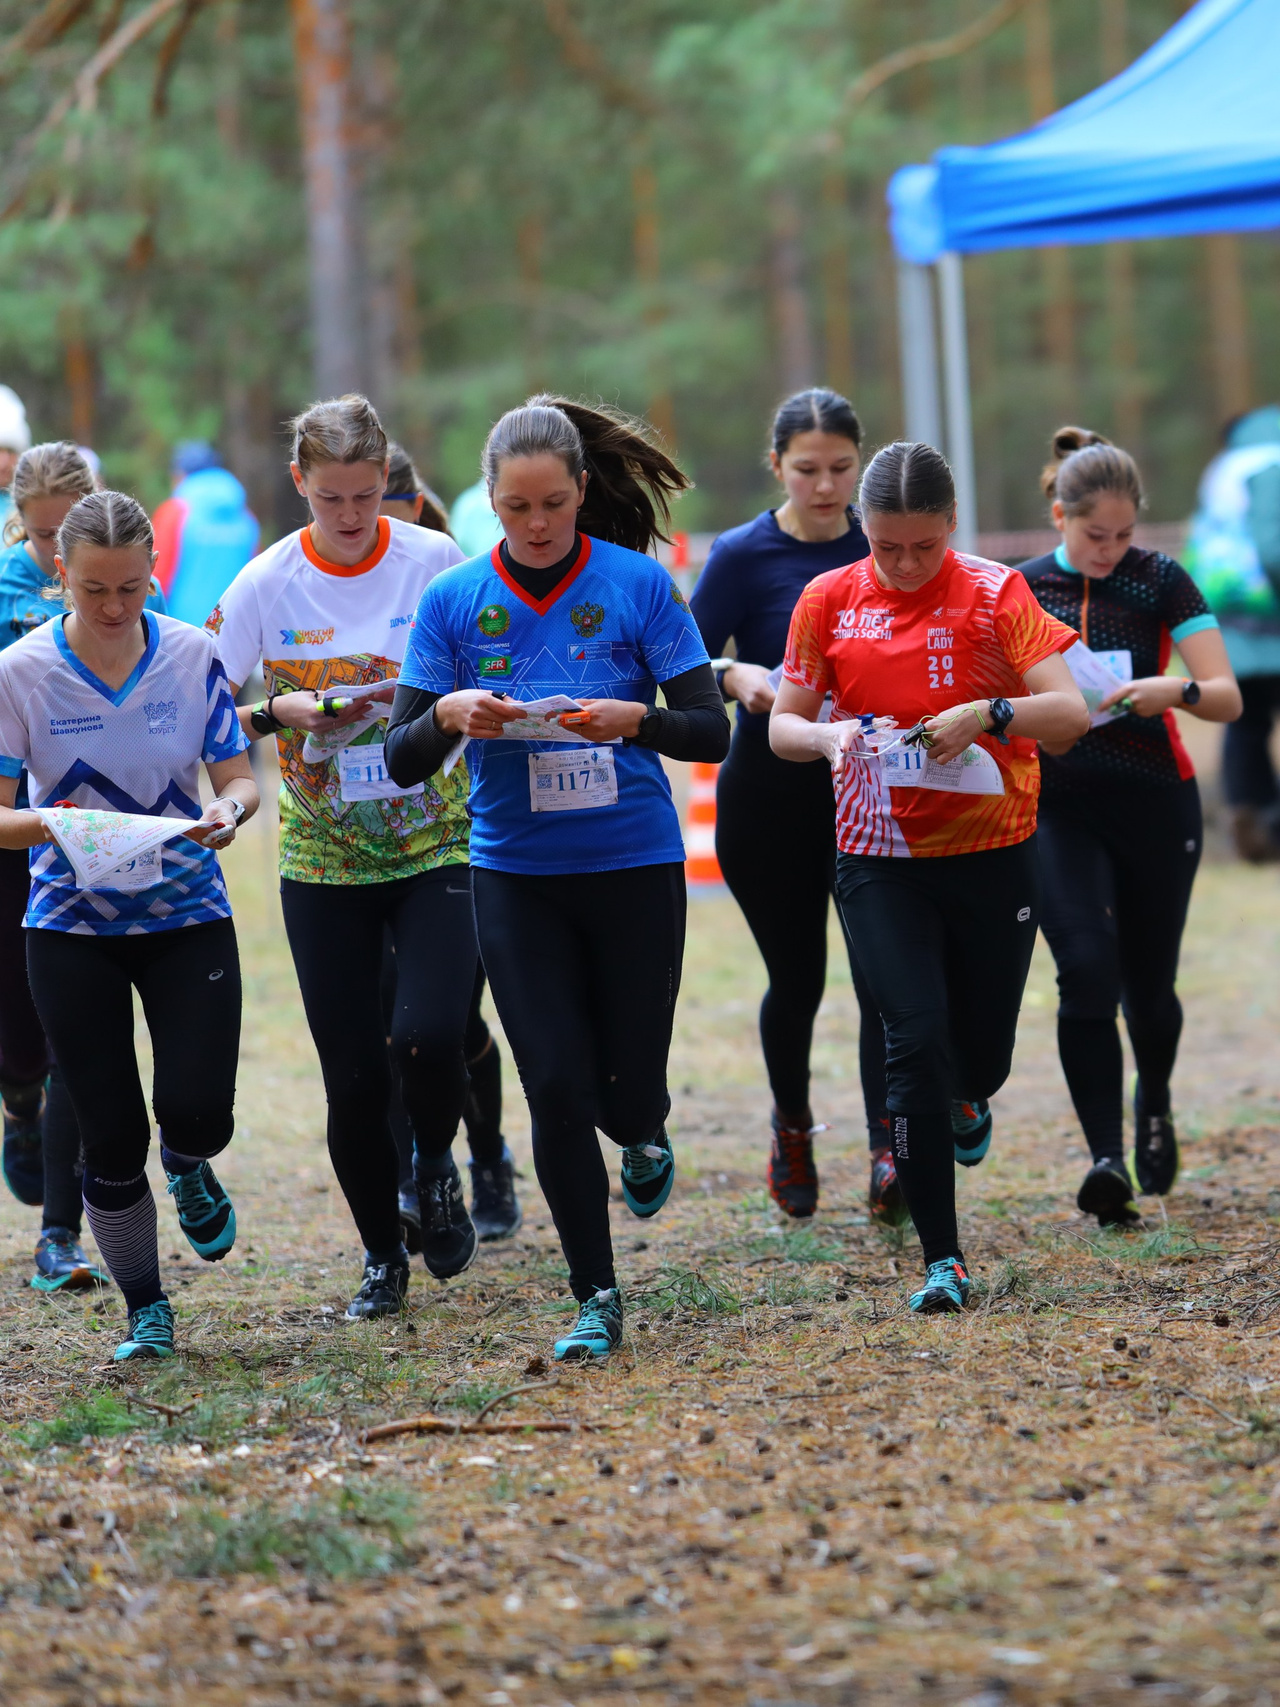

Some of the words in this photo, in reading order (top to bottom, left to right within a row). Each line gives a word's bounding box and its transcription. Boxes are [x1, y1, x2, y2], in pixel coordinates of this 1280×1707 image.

[836, 608, 856, 629] 10
[860, 628, 893, 640] SOCHI
[927, 627, 947, 637] IRON
[927, 636, 954, 650] LADY
[485, 658, 505, 670] SFR
[928, 655, 953, 671] 20
[929, 672, 954, 689] 24
[50, 715, 102, 727] Екатерина
[50, 724, 104, 736] Шавкунова
[557, 770, 591, 792] 117
